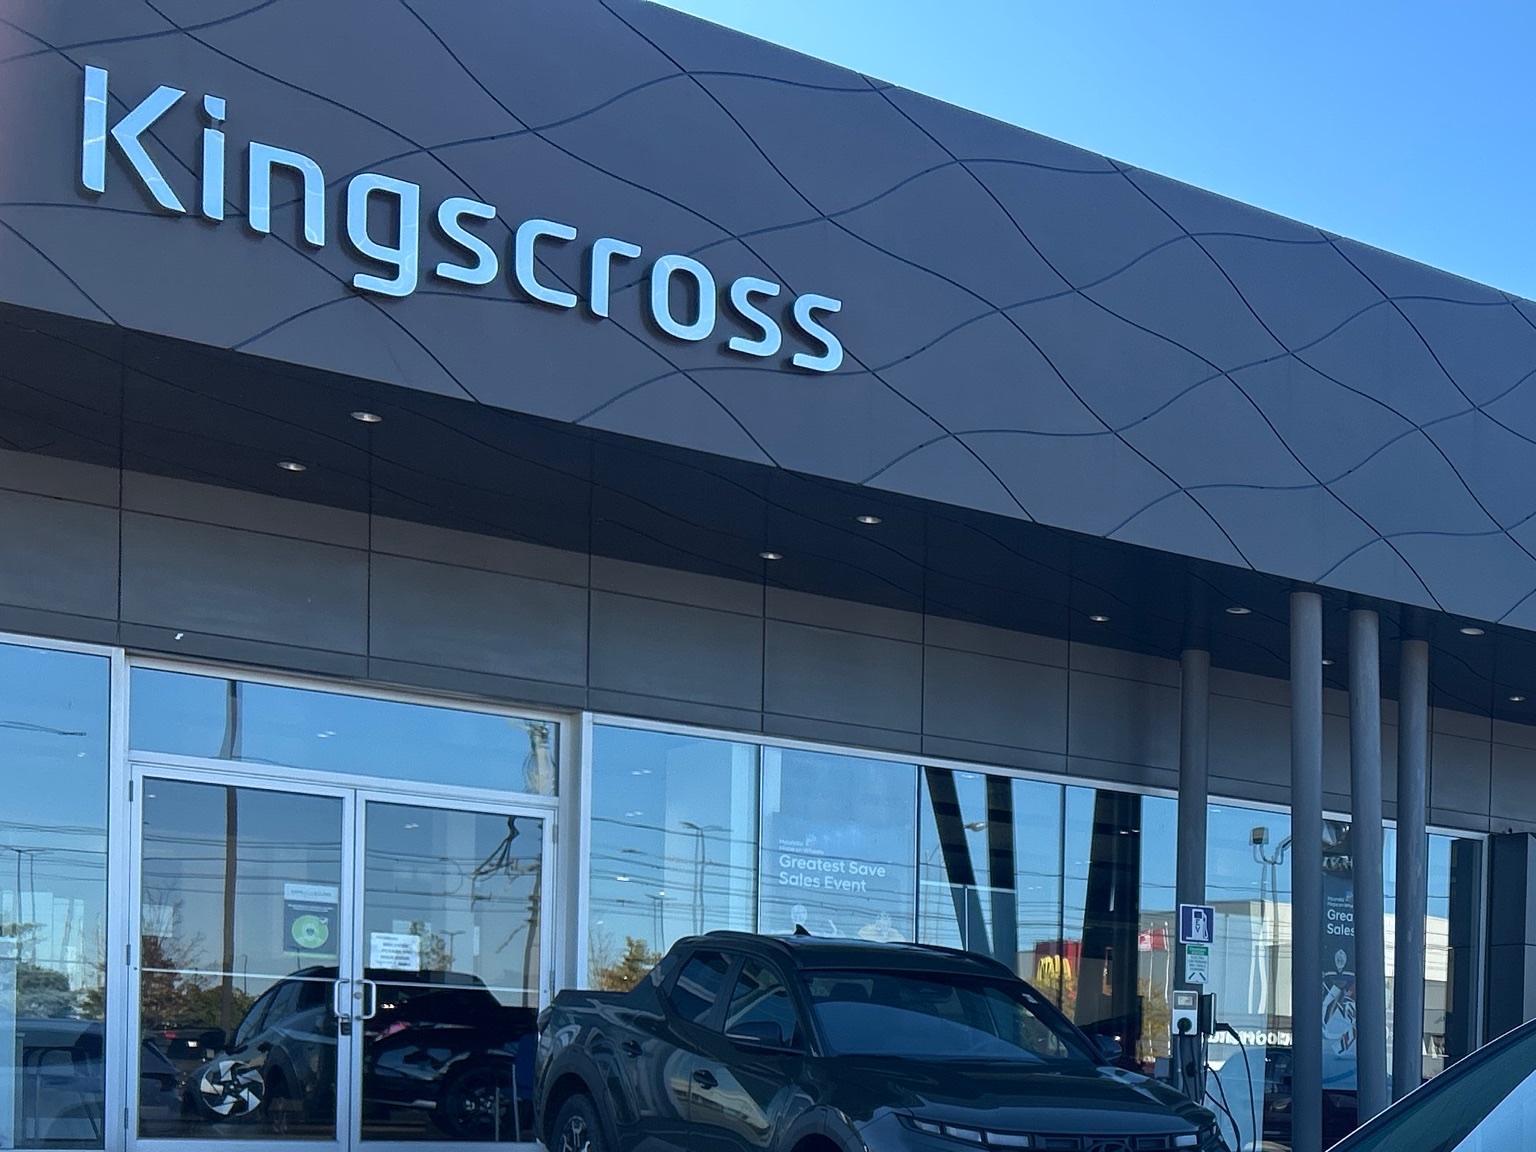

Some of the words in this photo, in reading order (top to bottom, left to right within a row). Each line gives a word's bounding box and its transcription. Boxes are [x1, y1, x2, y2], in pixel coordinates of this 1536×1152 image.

[81, 65, 843, 372] Kingscross
[779, 854, 846, 874] Greatest
[848, 860, 886, 877] Save
[778, 871, 820, 888] Sales
[824, 875, 867, 893] Event
[1326, 908, 1354, 922] Grea
